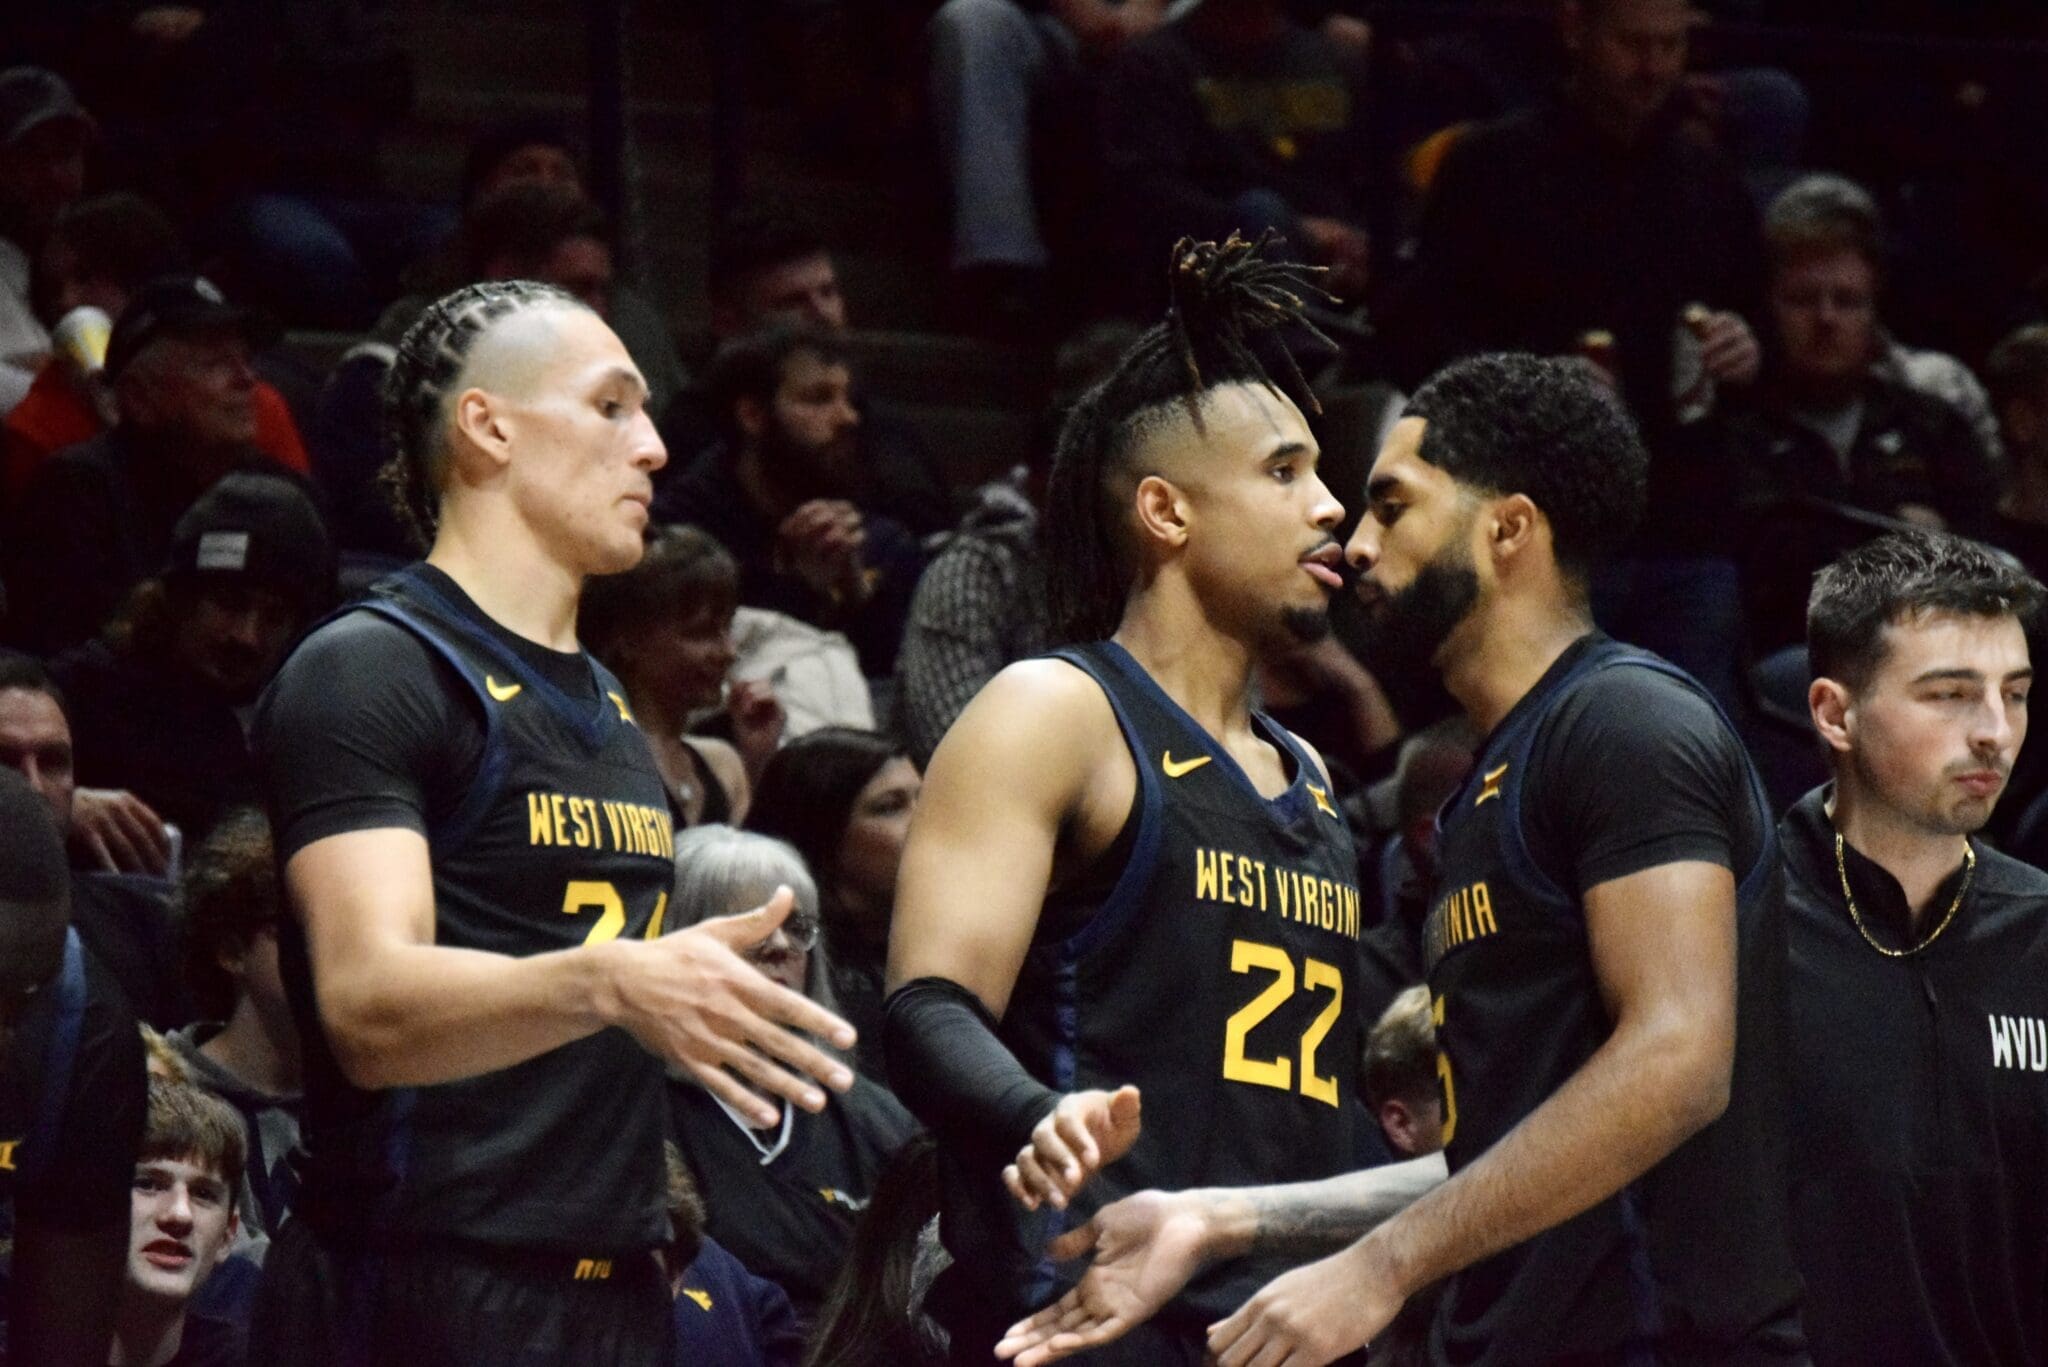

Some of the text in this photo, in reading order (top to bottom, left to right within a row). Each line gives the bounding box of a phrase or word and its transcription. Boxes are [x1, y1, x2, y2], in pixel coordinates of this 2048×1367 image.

[528, 793, 674, 858] WEST VIRGIN
[1196, 848, 1267, 912] WEST
[562, 880, 668, 947] 2
[1223, 939, 1343, 1108] 22
[1988, 1013, 2048, 1072] WVU
